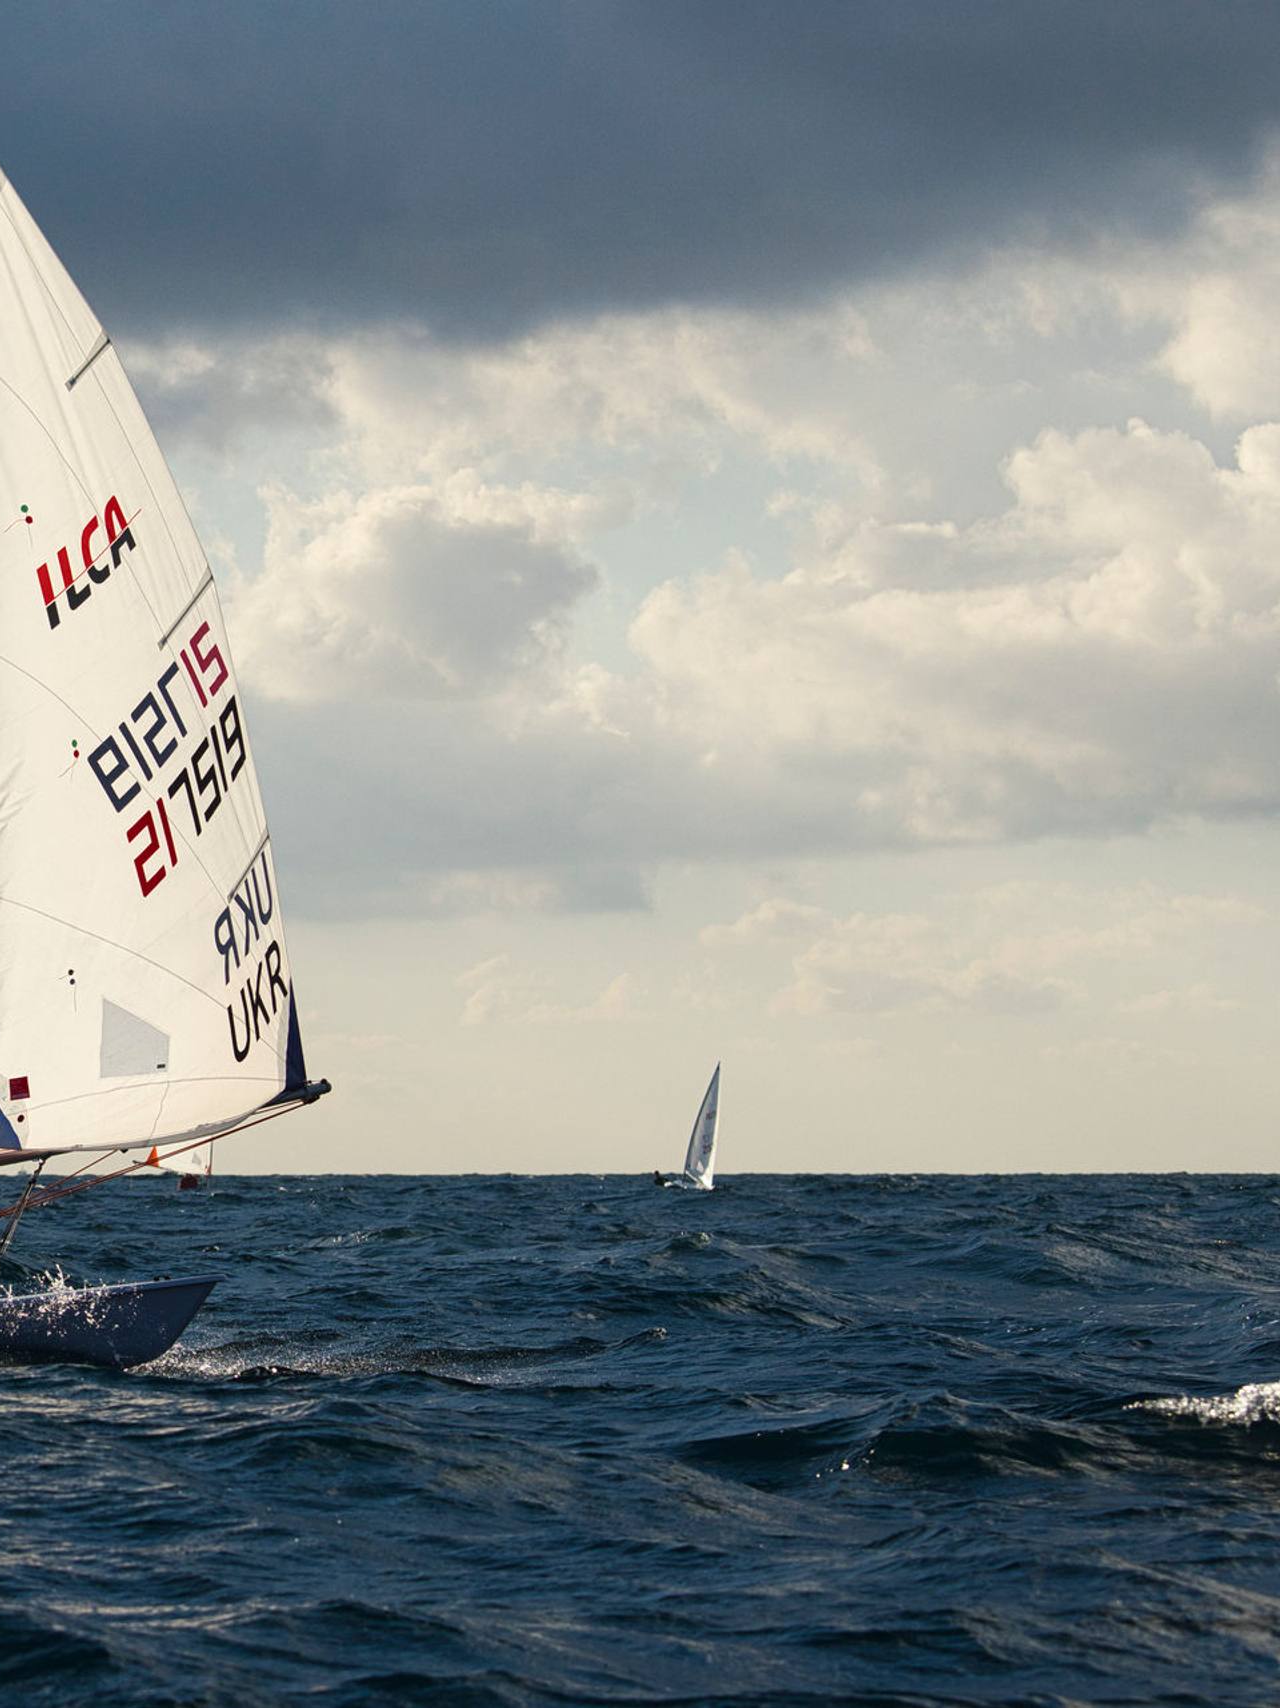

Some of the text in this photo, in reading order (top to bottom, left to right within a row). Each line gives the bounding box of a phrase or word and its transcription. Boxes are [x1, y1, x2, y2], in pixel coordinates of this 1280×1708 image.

[36, 495, 138, 630] ILCA
[126, 695, 247, 898] 217519
[227, 940, 288, 1063] UKR
